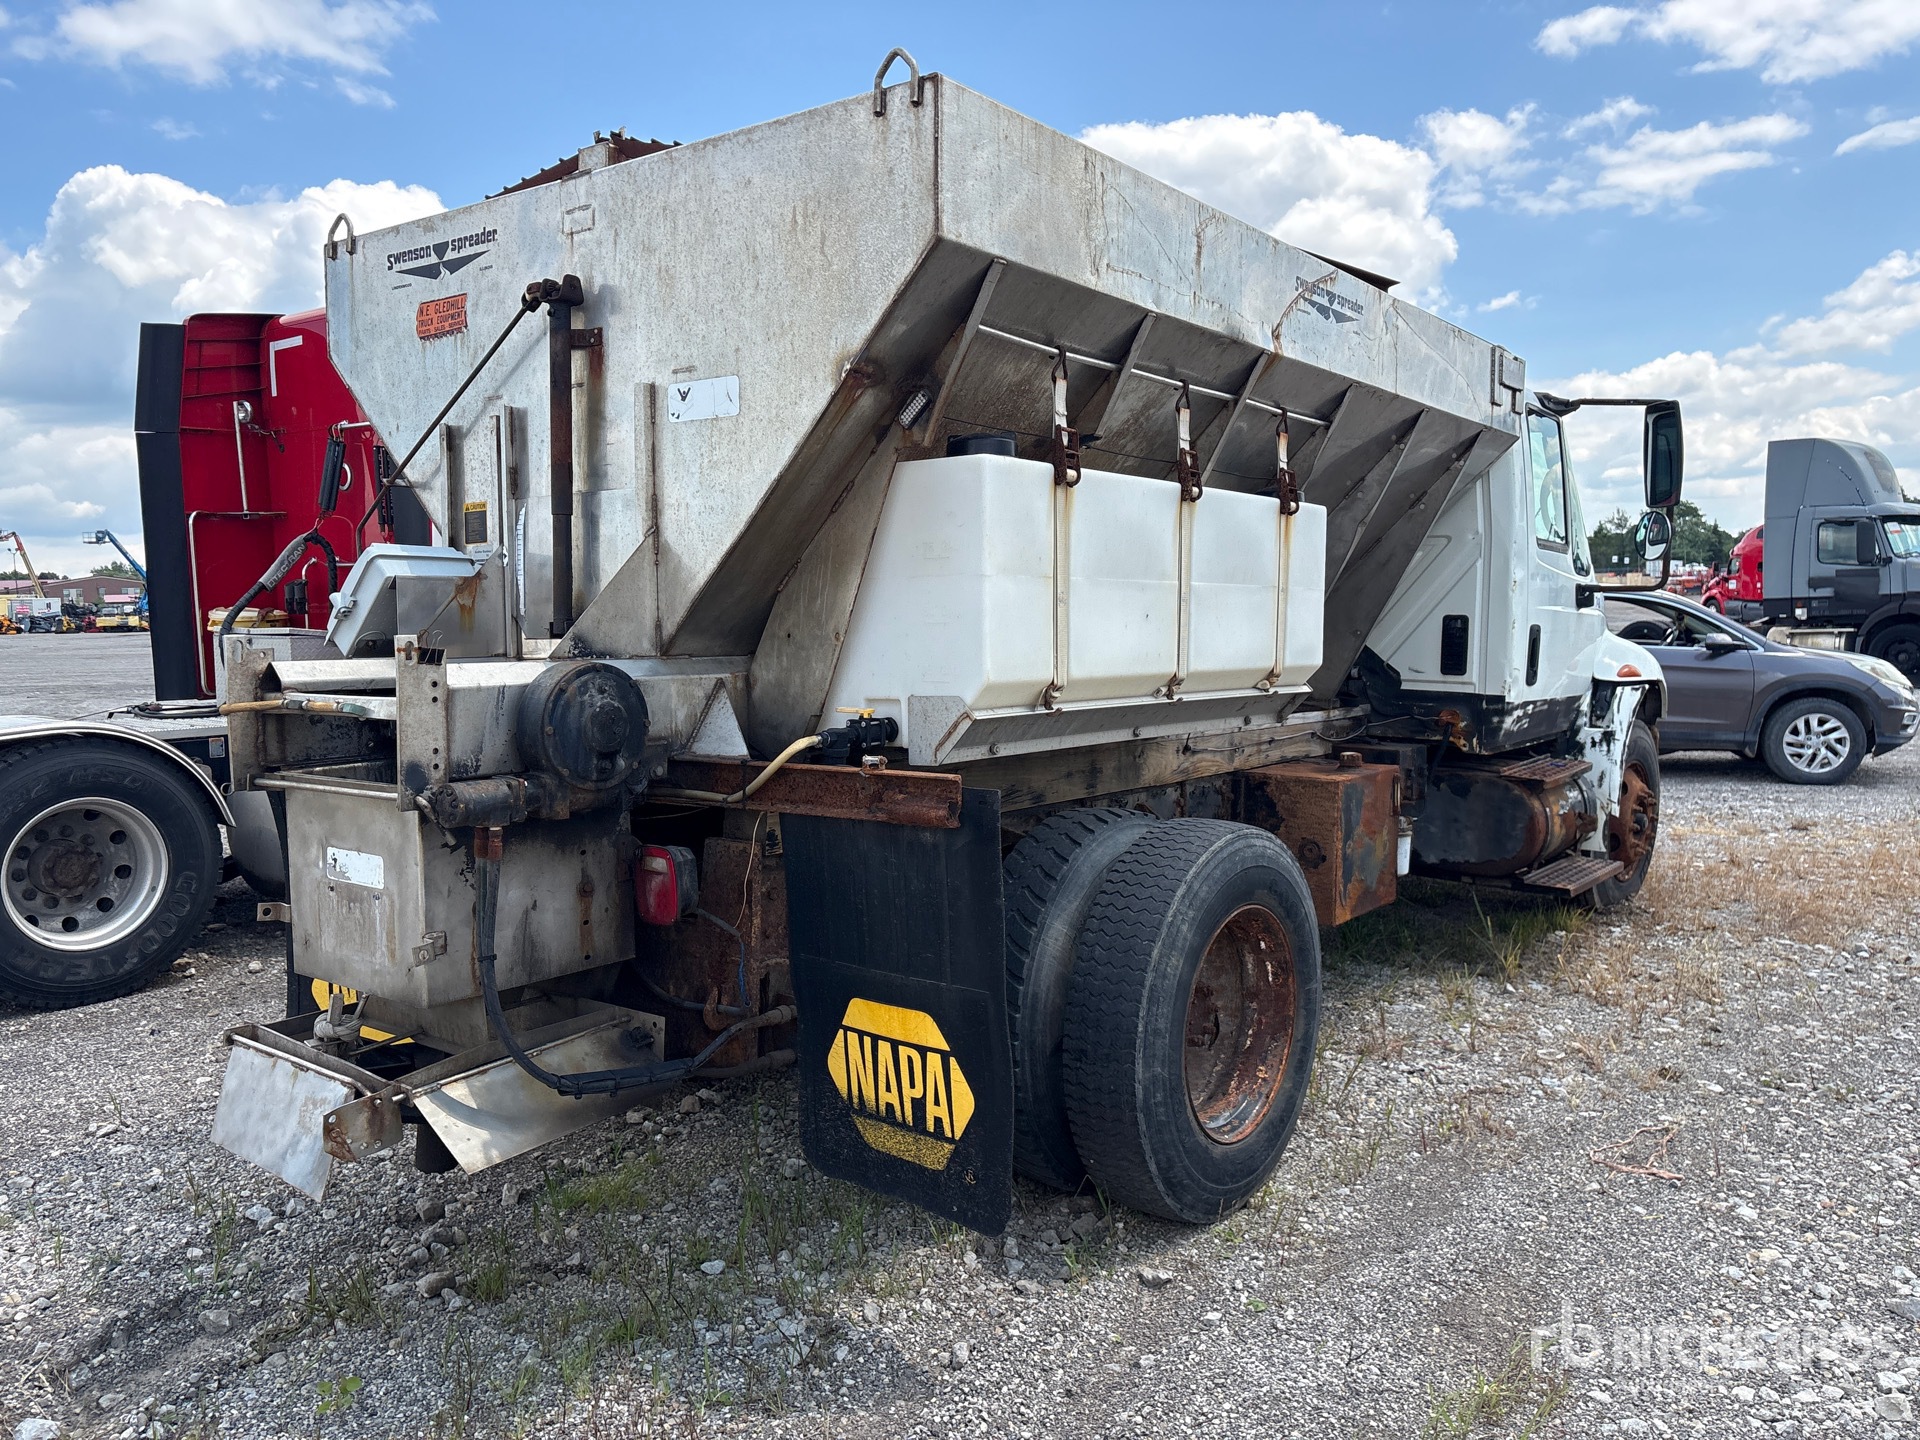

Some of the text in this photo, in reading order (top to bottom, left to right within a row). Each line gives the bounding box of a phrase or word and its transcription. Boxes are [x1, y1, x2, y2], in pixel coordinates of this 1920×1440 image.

[387, 227, 498, 271] Swenson spreader
[434, 297, 465, 315] GLEDHILL
[1336, 294, 1364, 316] spreader
[418, 310, 464, 329] TRUCK EQUIPMENT
[470, 503, 486, 511] CAUTION
[271, 543, 307, 585] TECTRAN
[847, 1030, 953, 1138] NAPA
